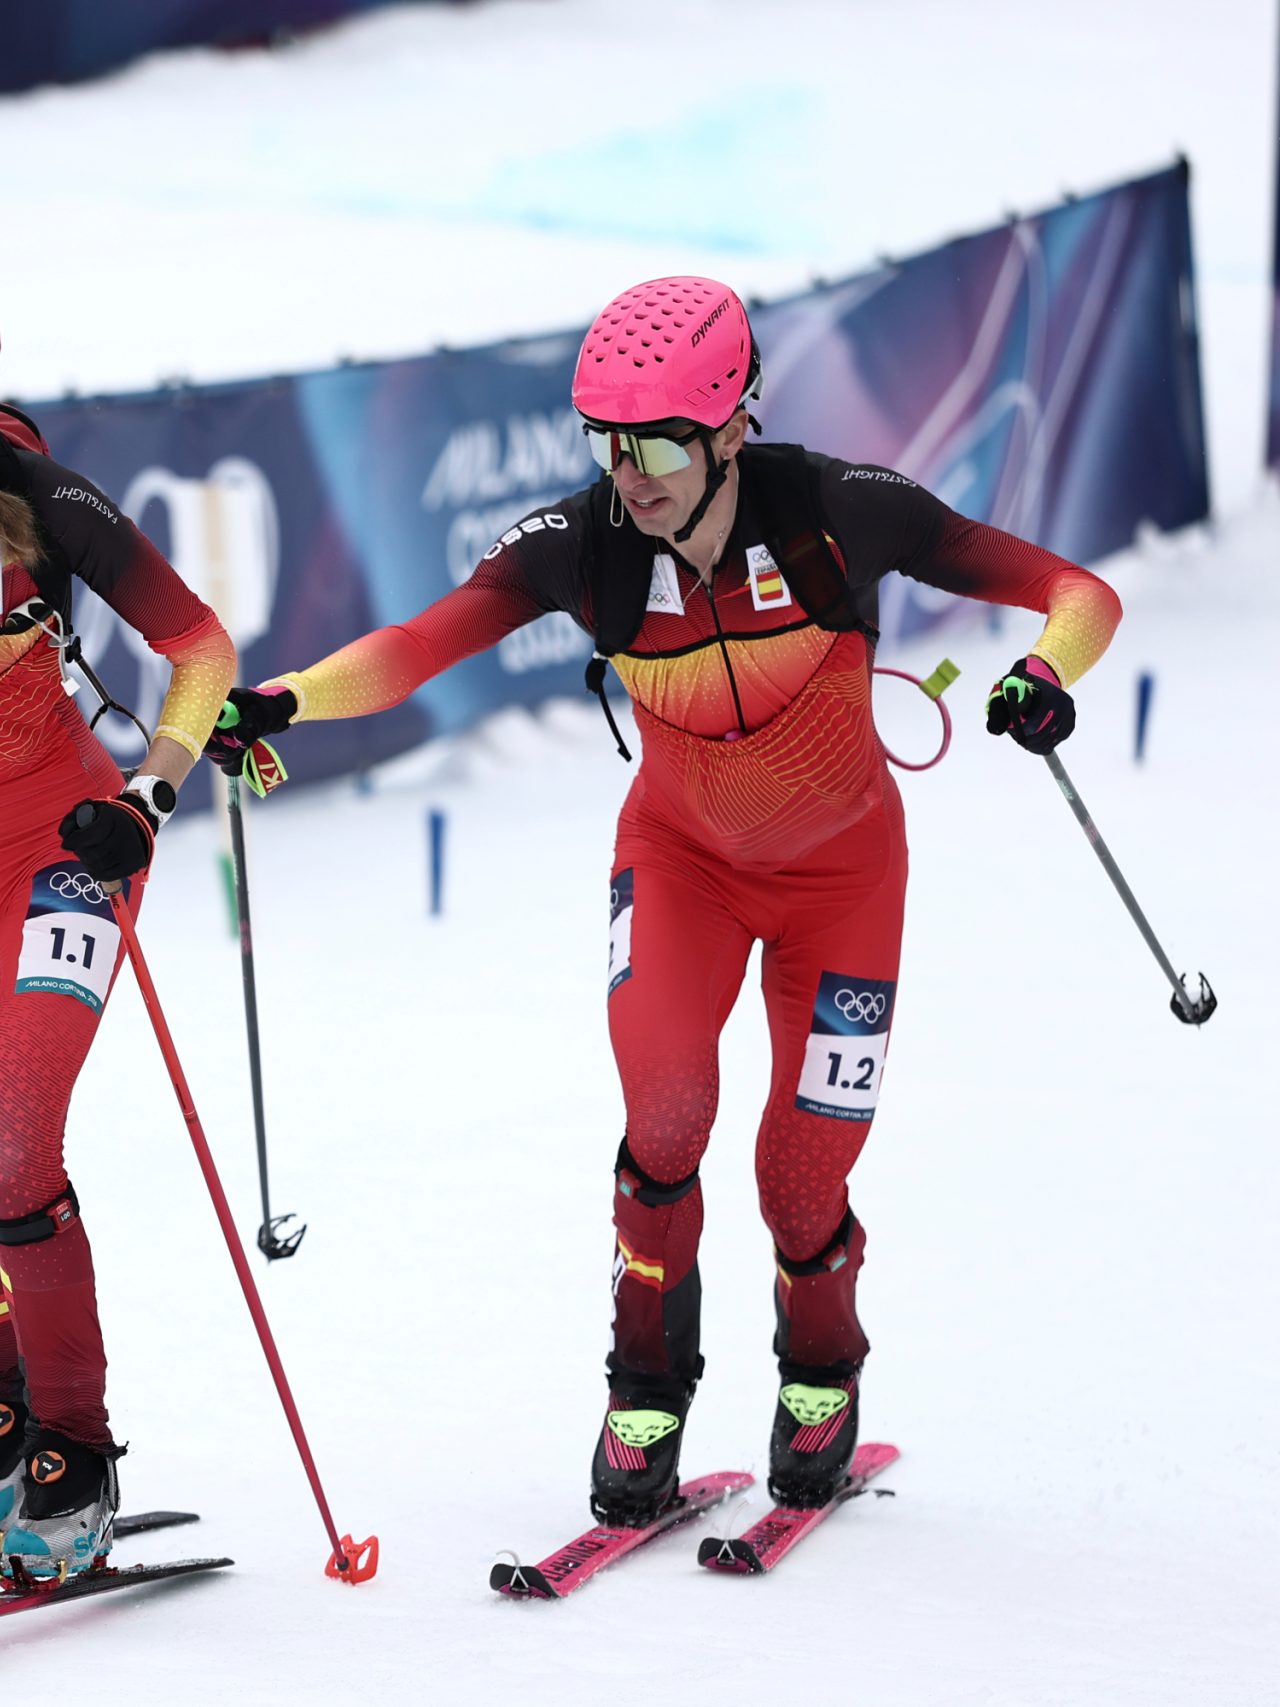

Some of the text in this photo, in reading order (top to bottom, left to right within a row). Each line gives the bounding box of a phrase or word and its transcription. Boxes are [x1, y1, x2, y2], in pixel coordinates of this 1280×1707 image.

[691, 298, 731, 348] DYNAFIT
[841, 469, 917, 488] FAST&LIGHT
[51, 486, 118, 524] FAST&LIGHT
[258, 762, 282, 791] KI
[50, 927, 96, 970] 1.1
[827, 1052, 875, 1090] 1.2
